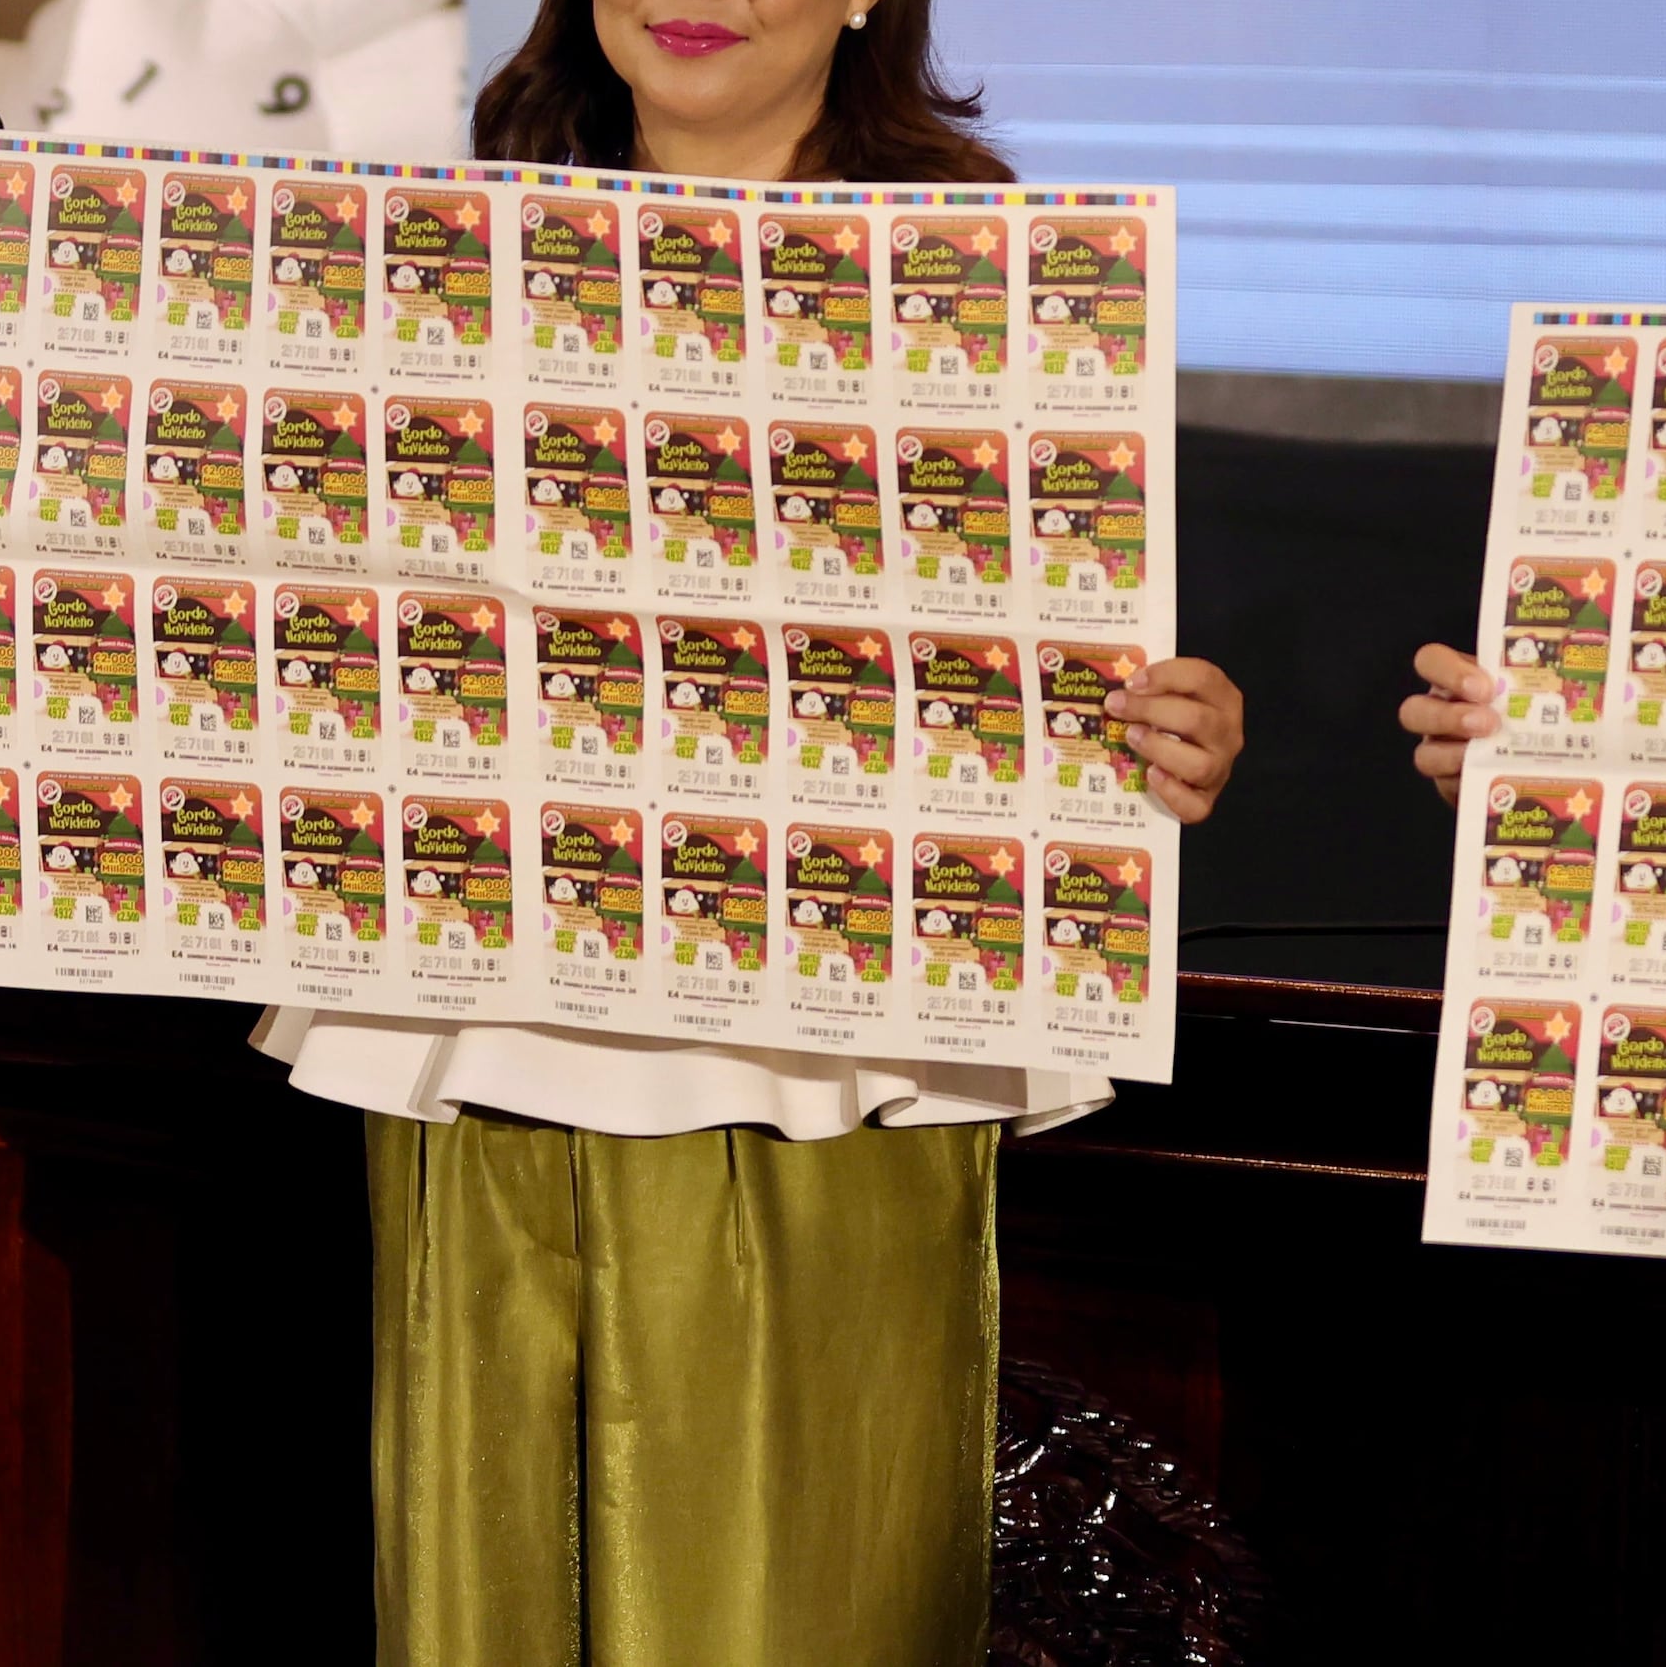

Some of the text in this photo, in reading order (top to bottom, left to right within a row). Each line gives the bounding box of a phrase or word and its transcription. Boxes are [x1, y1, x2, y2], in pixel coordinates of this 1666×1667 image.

[63, 194, 100, 214] Gordo
[399, 217, 440, 238] Gordo
[776, 242, 818, 263] Gordo
[1047, 244, 1091, 267] Gordo
[162, 409, 199, 428] Gordo
[401, 425, 443, 445] Gordo
[660, 441, 701, 461] Gordo
[168, 606, 207, 625] Gordo
[296, 816, 335, 835] Gordo
[678, 842, 718, 862] Gordo
[1061, 872, 1101, 891] Gordo
